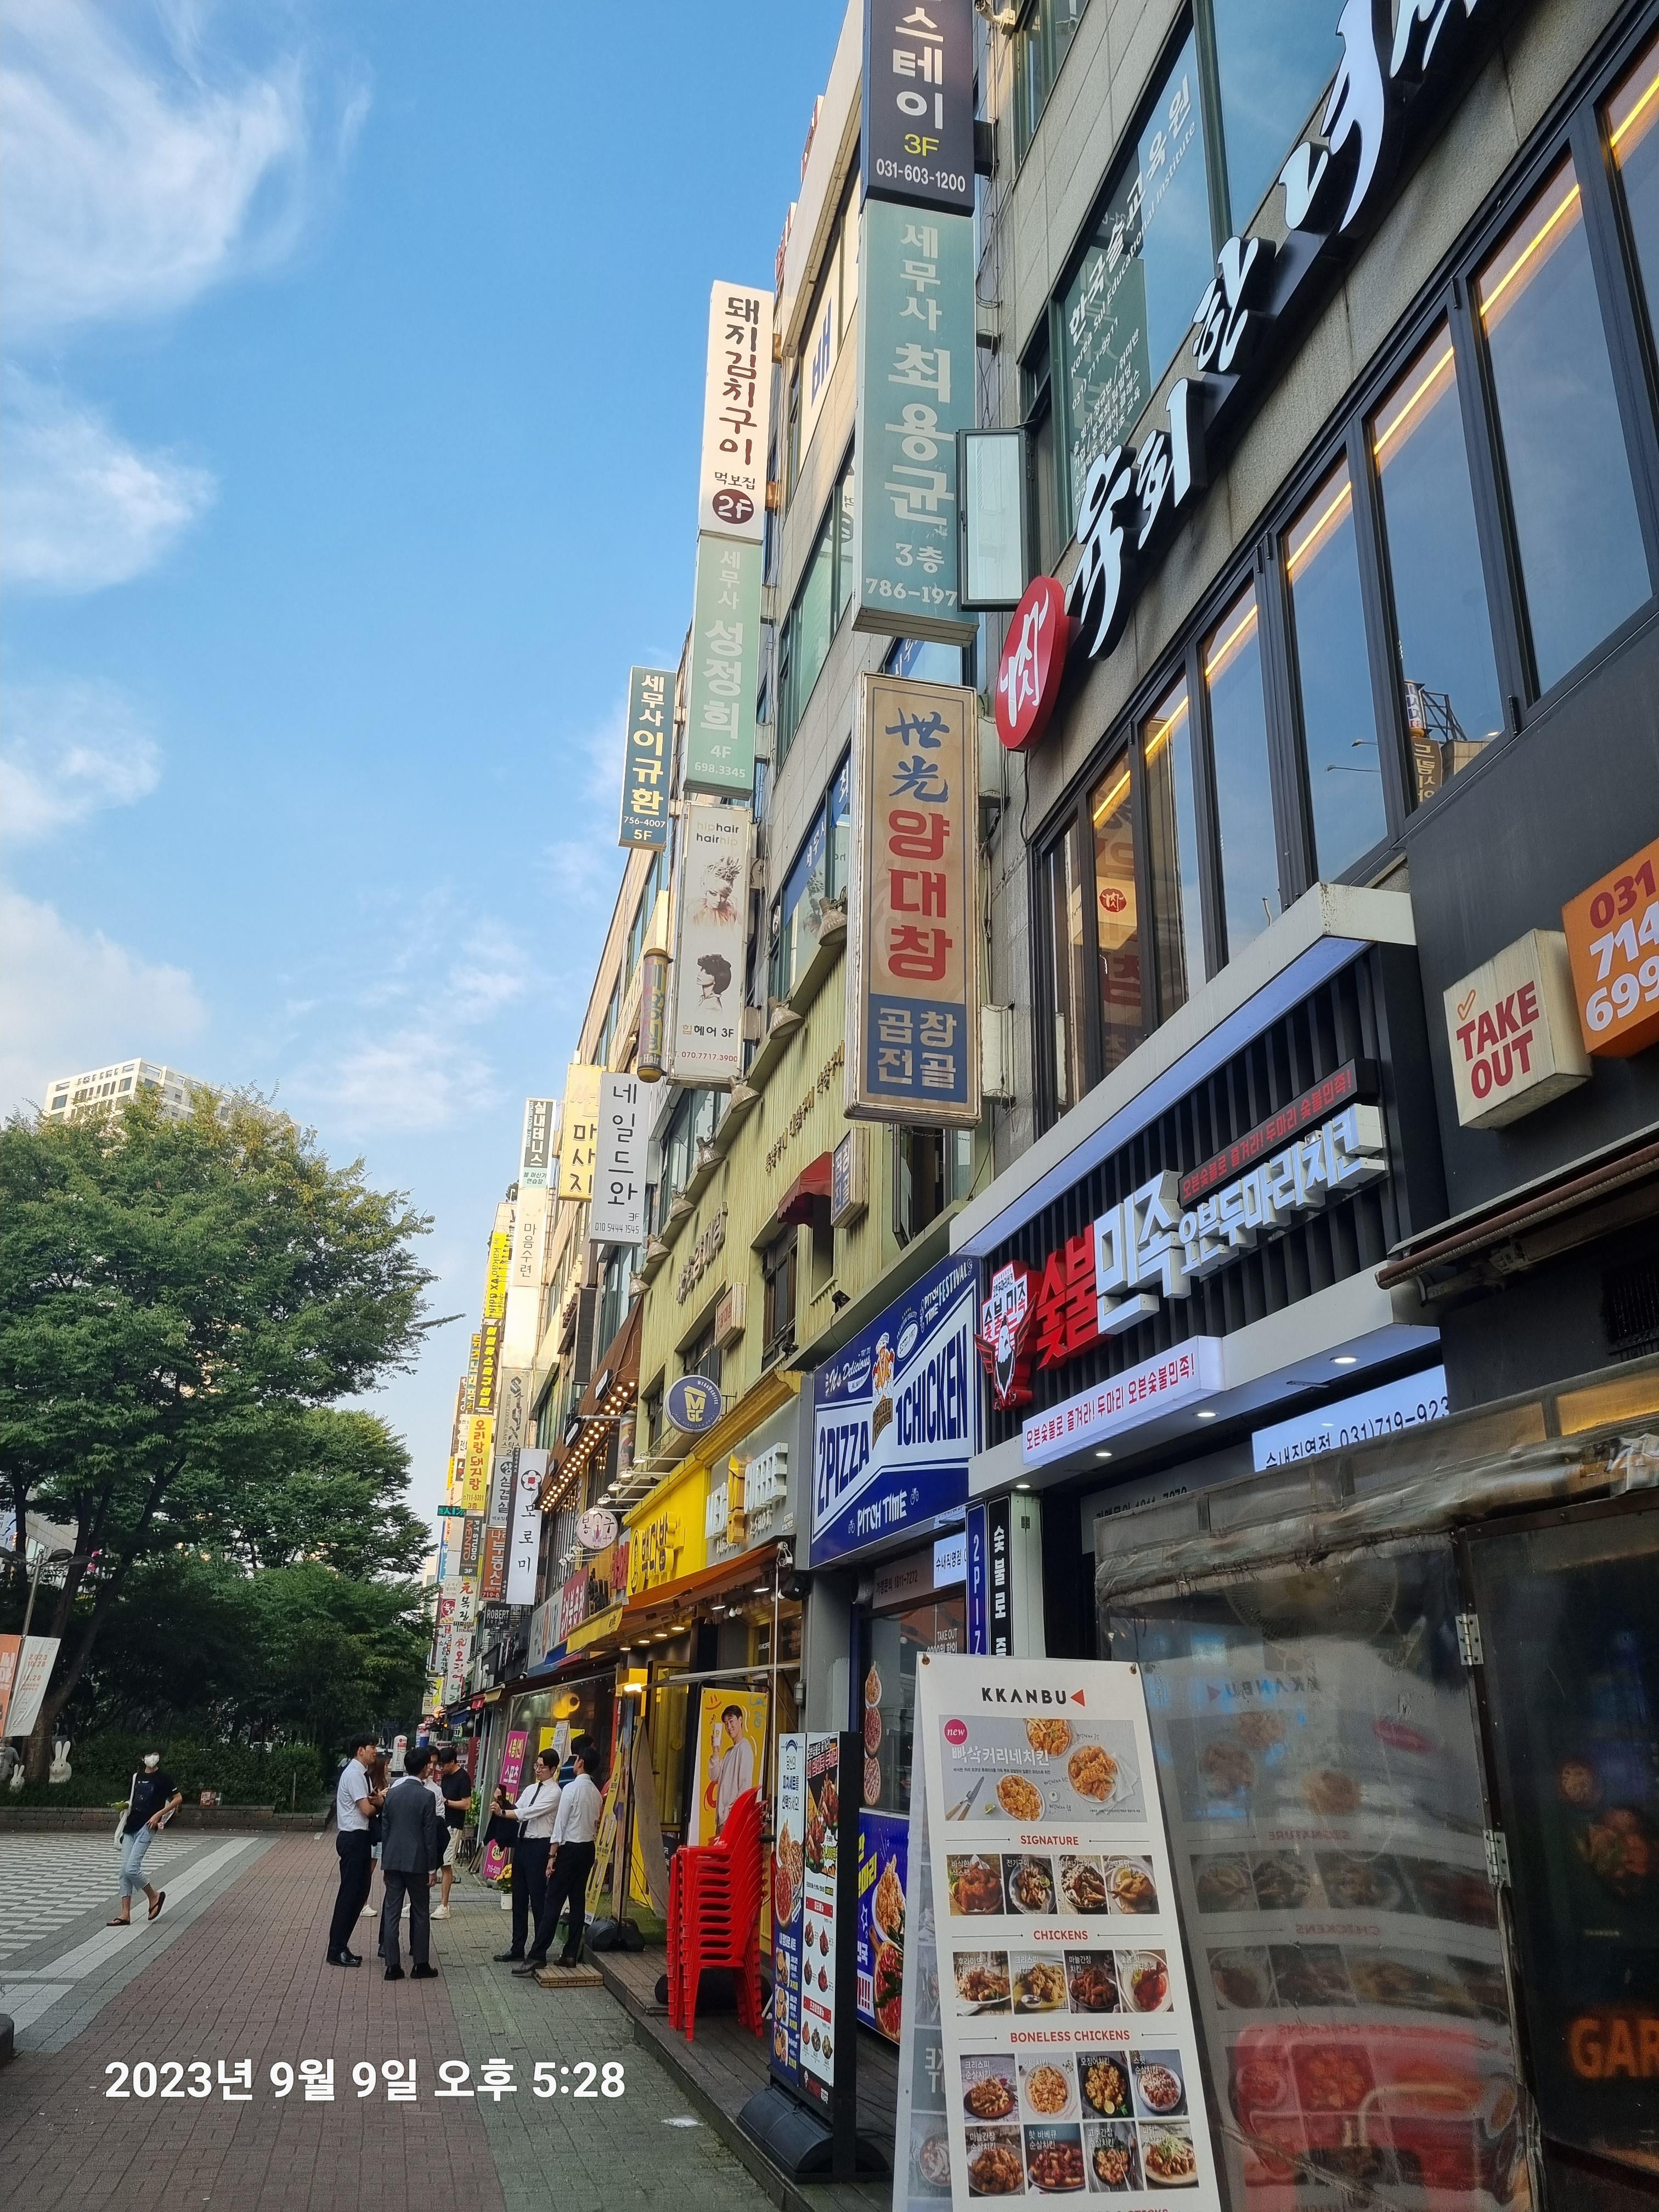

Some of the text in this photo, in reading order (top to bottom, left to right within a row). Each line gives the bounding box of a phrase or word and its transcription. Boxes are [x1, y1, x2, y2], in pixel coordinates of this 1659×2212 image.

[893, 7, 944, 129] 스테이
[904, 134, 939, 156] 3F
[876, 158, 966, 193] 031-603-1200
[1069, 74, 1192, 347] 한국술교육원
[1071, 331, 1093, 379] Korea
[1094, 303, 1106, 332] Sul
[1107, 211, 1155, 314] Educational
[1155, 121, 1197, 206] Institute
[1119, 328, 1139, 370] 취미반
[884, 224, 955, 526] 세무사 최용균
[714, 471, 755, 490] 먹보집
[718, 495, 752, 519] 2F
[895, 542, 945, 574] 3층
[700, 550, 744, 740] 세무사 성정희
[630, 674, 664, 816] 세무사 이규환
[711, 745, 731, 759] 4F
[695, 762, 746, 778] 698.3345
[623, 816, 666, 829] 756-4007
[634, 829, 652, 840] 5F
[888, 809, 953, 981] 양대창
[1590, 860, 1657, 929] 031
[1589, 900, 1659, 981] 714
[682, 1024, 734, 1038] 힙헤어 3F
[878, 1007, 957, 1048] 곱창
[1456, 980, 1539, 1062] TAKE
[643, 1053, 660, 1064] Hair
[682, 1051, 737, 1063] 070.7717.3900
[878, 1047, 957, 1089] 전골
[1471, 1029, 1533, 1099] OUT
[530, 1102, 547, 1166] 실내테니스
[607, 1084, 638, 1206] 네일드와
[1267, 1116, 1297, 1147] 두마리
[570, 1124, 598, 1195] 마사지
[1180, 1103, 1374, 1276] 오븐두마리치킨
[595, 1222, 639, 1234] 010 5444 1545
[629, 1212, 640, 1221] 3F
[520, 1223, 537, 1278] 마음수련
[925, 1286, 939, 1309] PITCH
[939, 1262, 968, 1306] FESTIVAL
[925, 1302, 939, 1325] TIME
[843, 1356, 871, 1381] Delicious
[896, 1323, 969, 1447] 1CHICKEN
[1025, 1352, 1196, 1452] 오븐숯불로 즐겨라! 두마리 오븐숯불민족!
[817, 1421, 870, 1518] 2PIZZA
[857, 1500, 881, 1537] PITCH
[882, 1489, 907, 1522] TIME
[463, 1520, 473, 1561] MENTO
[471, 1533, 479, 1561] STUDIO
[517, 1503, 537, 1575] 모로미
[935, 1551, 962, 1572] 수내직영점
[948, 1628, 958, 1639] OUT
[981, 1687, 1066, 1705] KKANBU
[946, 1726, 965, 1737] new
[1020, 1835, 1079, 1846] SIGNATURE
[1033, 1930, 1088, 1941] CHICKENS
[1069, 1956, 1092, 1965] 마늘간장
[1070, 1965, 1082, 1974] 치킨
[1011, 2030, 1130, 2044] BONELESS CHICKENS
[964, 2061, 990, 2069] 크리스피
[1081, 2057, 1110, 2066] 오징어치킨
[966, 2070, 991, 2080] 순살치킨
[969, 2132, 996, 2141] 마늘간장
[970, 2142, 996, 2152] 순살치킨
[1029, 2140, 1056, 2151] 순살치킨
